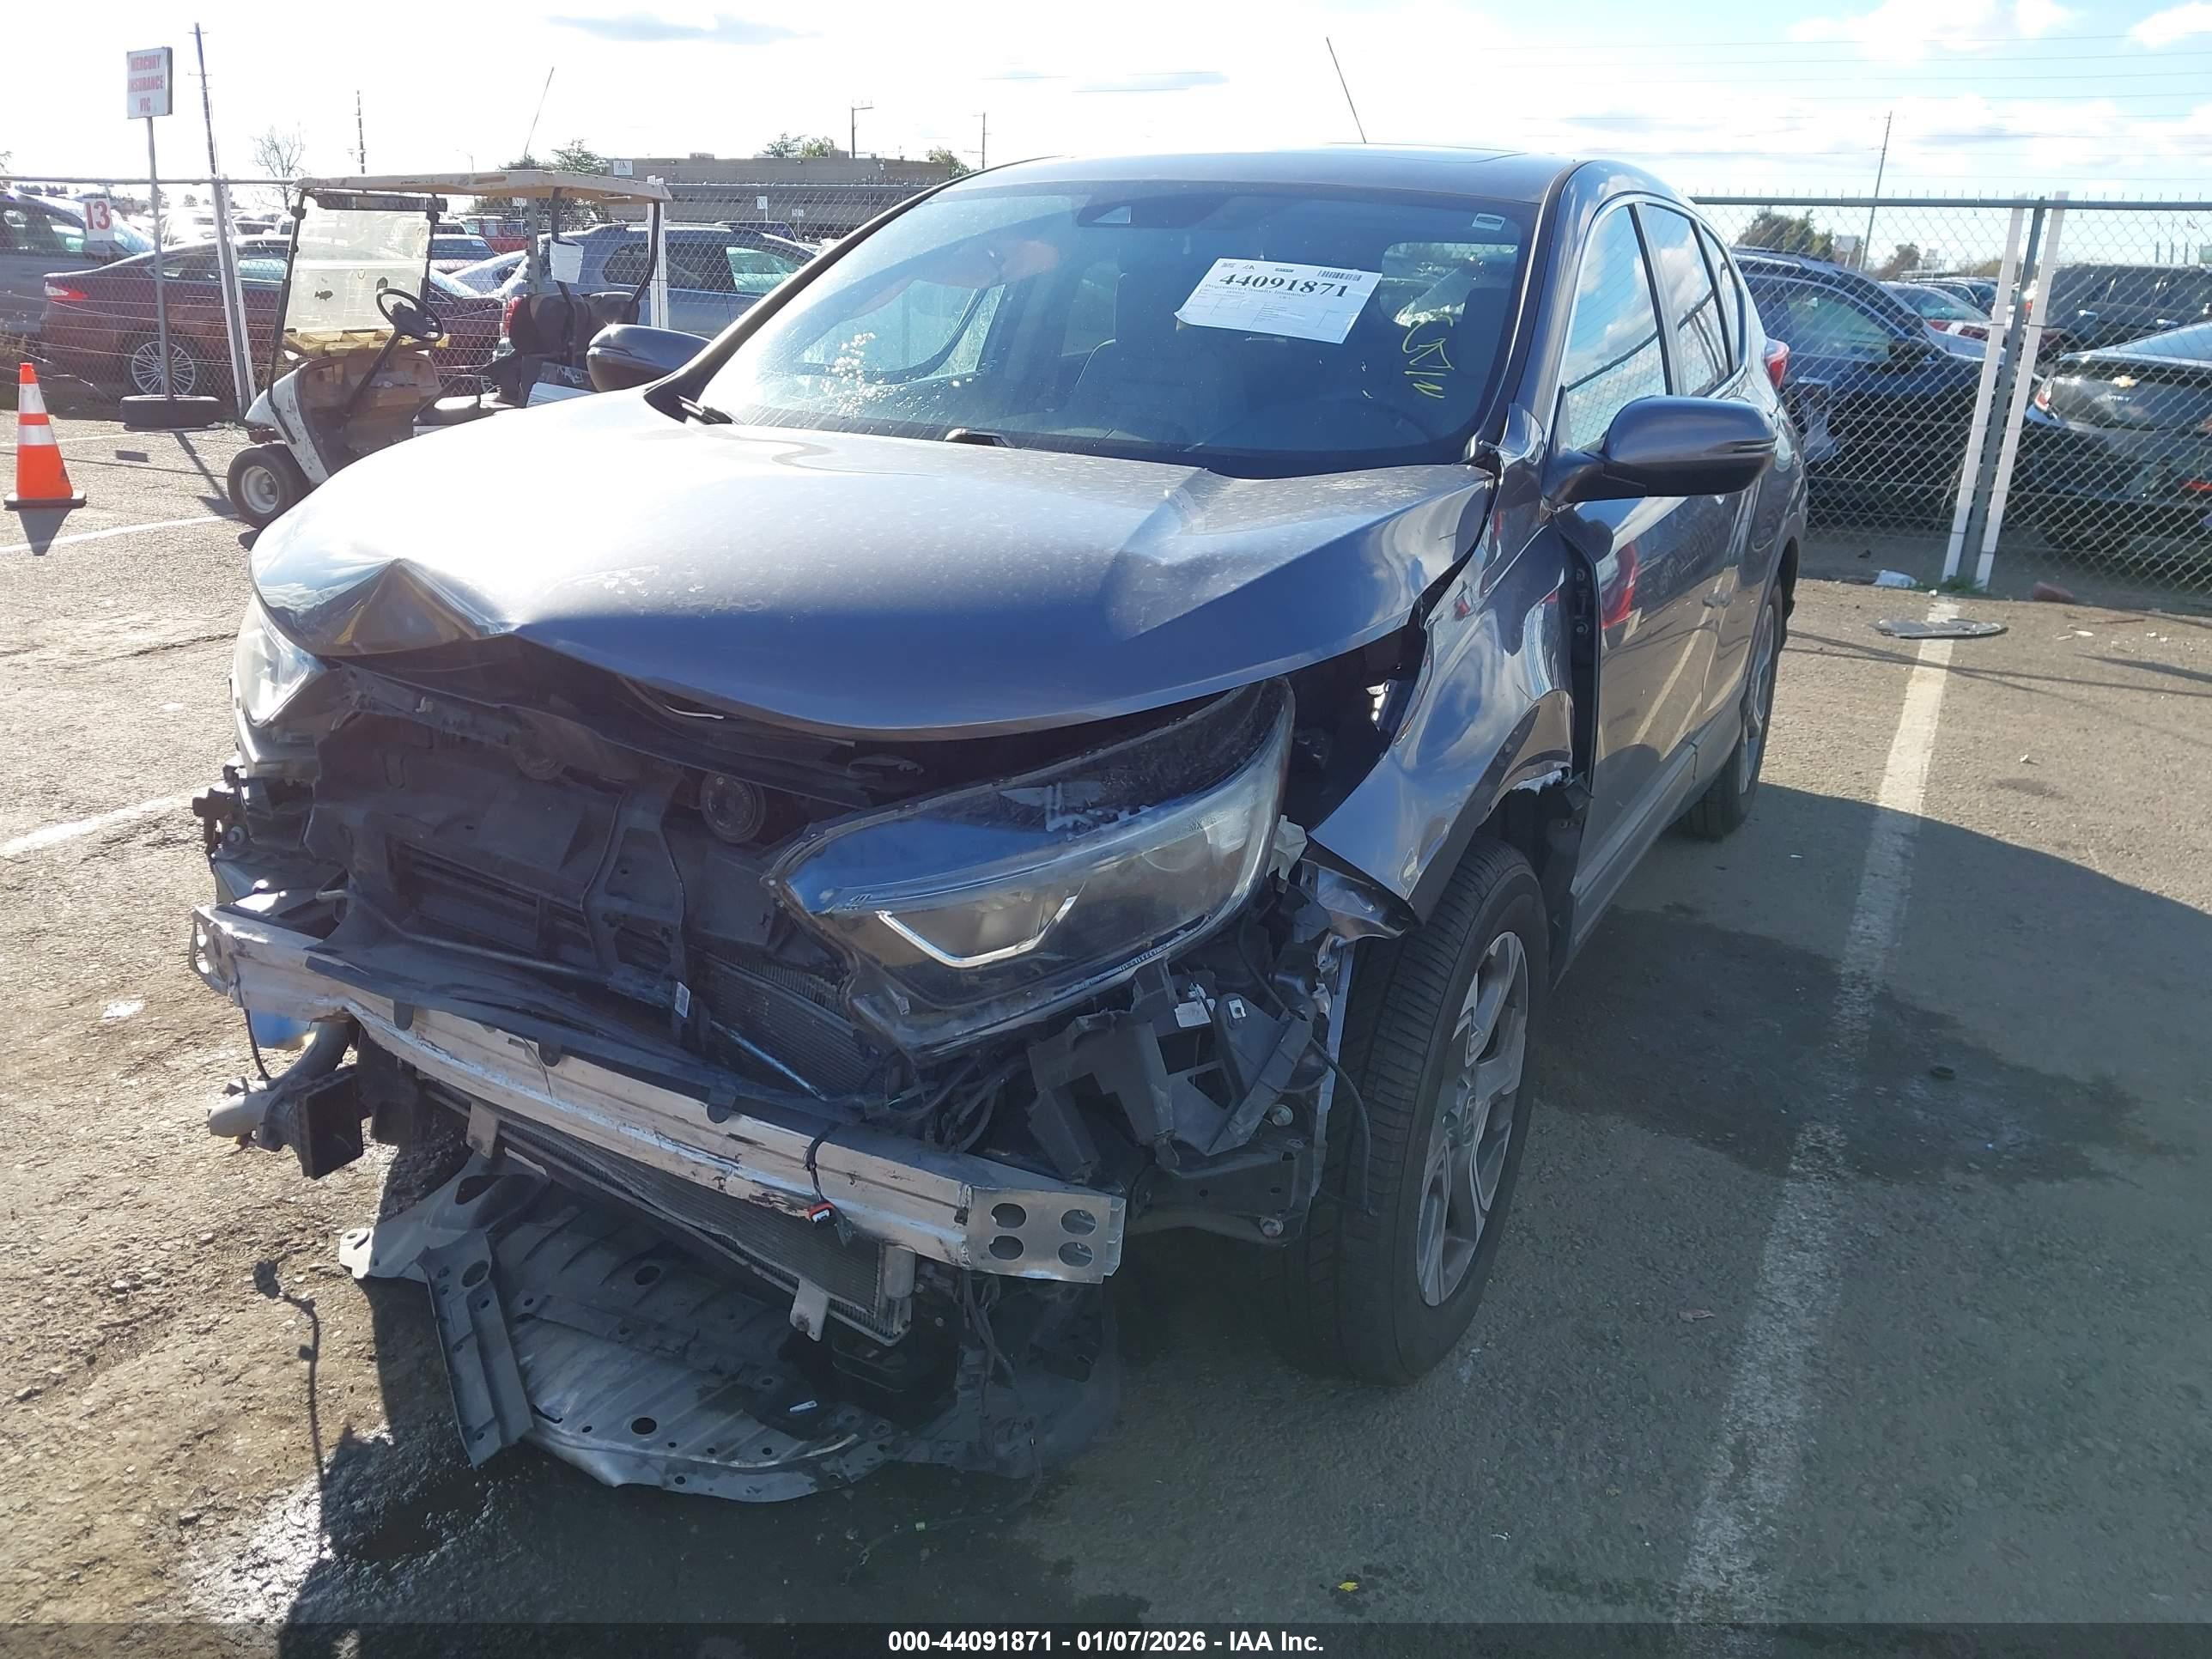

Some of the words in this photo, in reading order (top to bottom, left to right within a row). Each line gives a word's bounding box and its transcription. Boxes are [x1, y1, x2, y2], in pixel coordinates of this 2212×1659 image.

[131, 54, 161, 71] MERCURY
[85, 200, 111, 229] 13
[1219, 273, 1348, 297] 44091871
